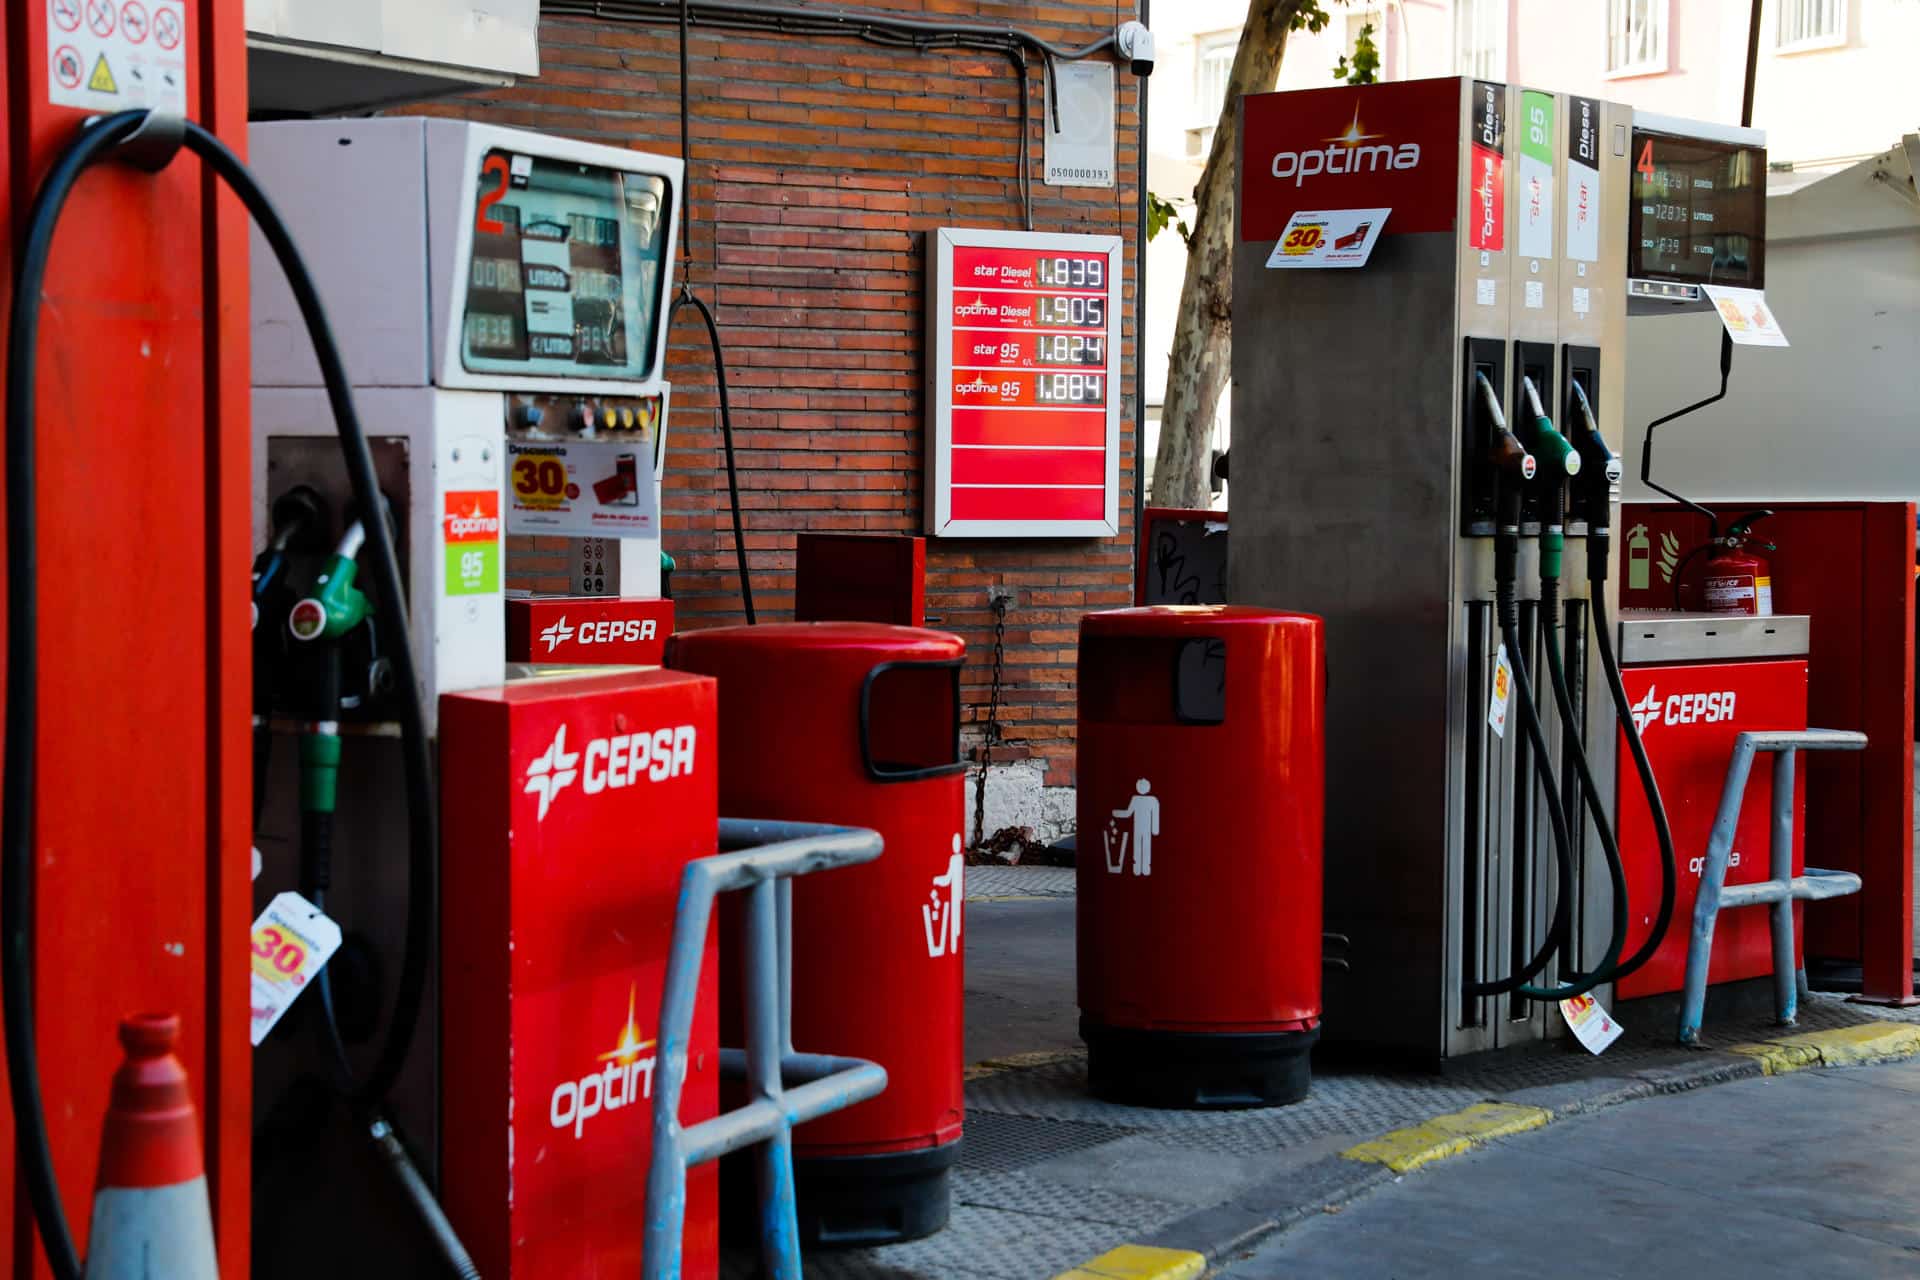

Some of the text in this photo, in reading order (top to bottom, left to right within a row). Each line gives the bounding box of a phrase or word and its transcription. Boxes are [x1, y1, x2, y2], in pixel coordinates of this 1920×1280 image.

[1483, 85, 1496, 145] Diesel
[1530, 105, 1545, 145] 95
[1579, 100, 1591, 159] Diesel
[1271, 143, 1421, 188] optima
[1636, 139, 1656, 184] 4
[475, 155, 510, 235] 2
[1482, 157, 1497, 238] optima
[1284, 229, 1321, 248] 30
[973, 258, 1102, 287] star Diesel 1.839
[955, 296, 1101, 325] optima Diesel 1.905
[973, 335, 1101, 362] star 95 1.824
[955, 373, 1100, 401] optima 95 1.884
[508, 444, 567, 457] Descuento
[513, 459, 564, 496] 30
[450, 517, 498, 540] optima
[461, 550, 485, 578] 95
[577, 619, 658, 645] CEPSA
[1663, 691, 1736, 727] CEPSA
[582, 724, 697, 796] CEPSA
[252, 927, 306, 974] 30
[550, 1055, 658, 1140] optim
